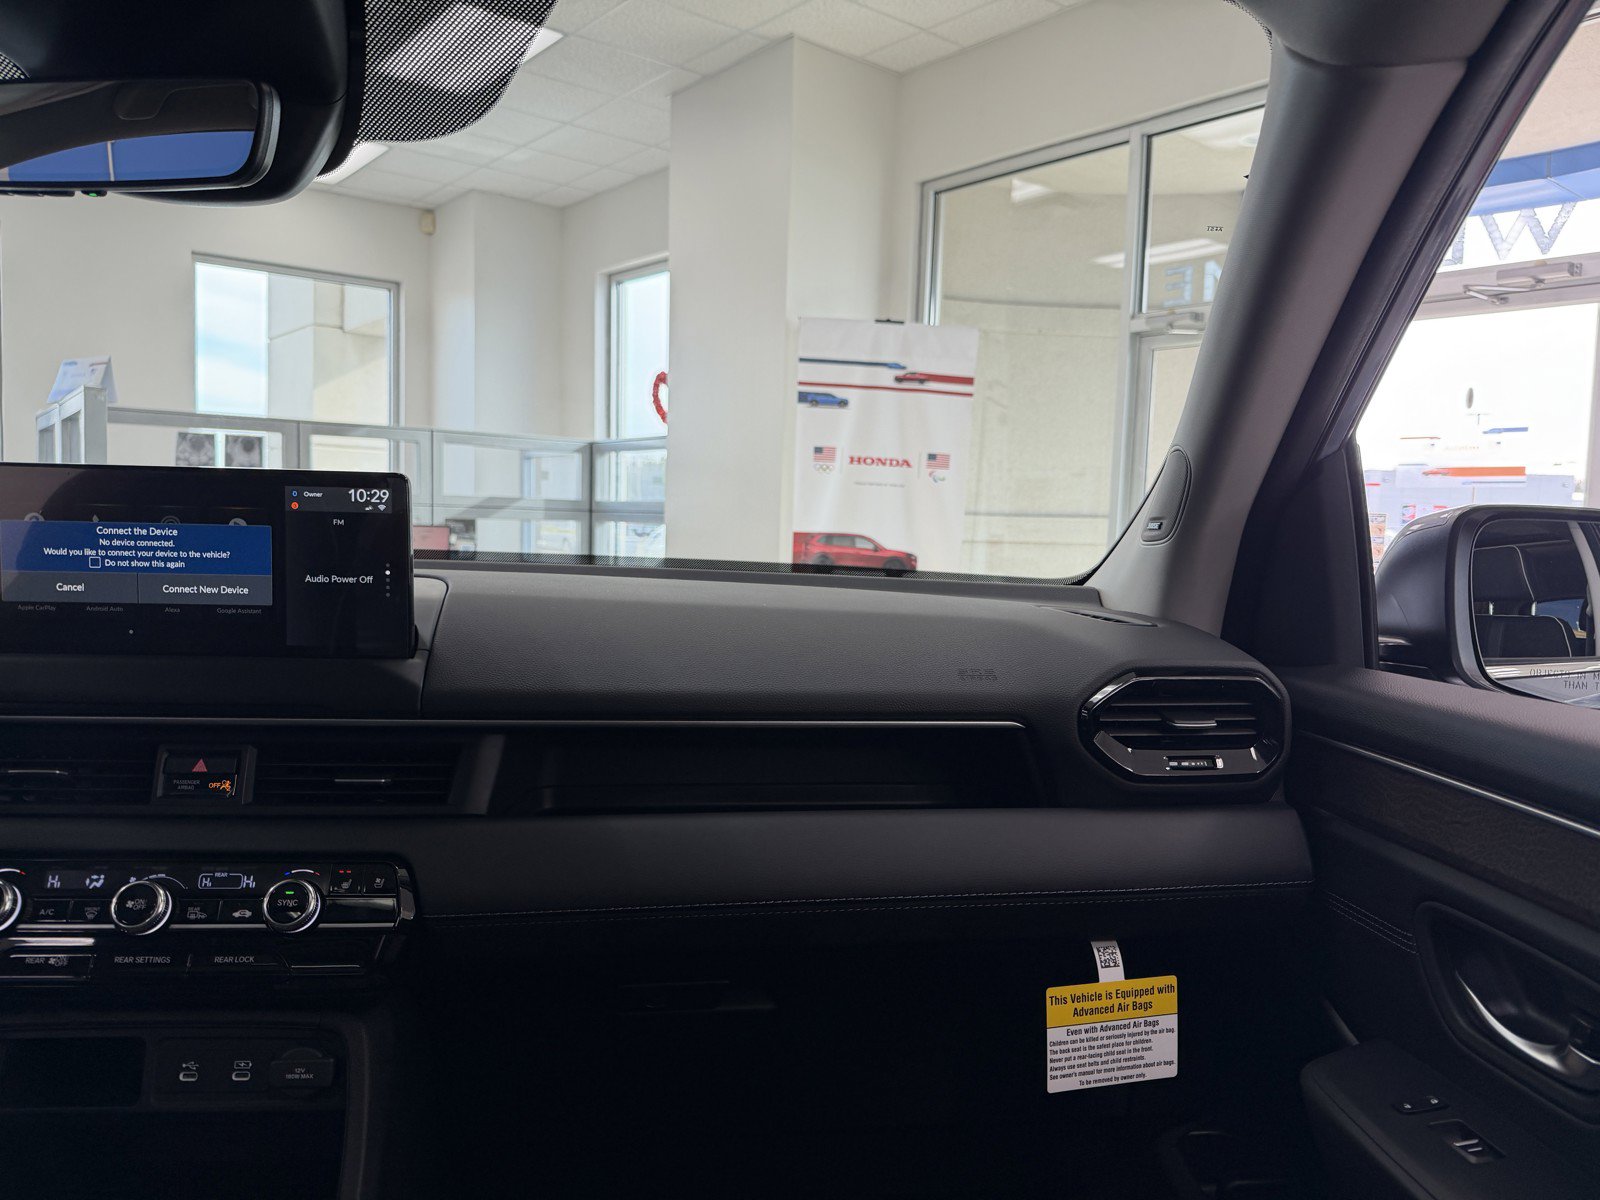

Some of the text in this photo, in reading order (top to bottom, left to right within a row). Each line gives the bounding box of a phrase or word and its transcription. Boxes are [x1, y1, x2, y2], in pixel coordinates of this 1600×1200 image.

[849, 456, 913, 468] HONDA
[348, 489, 389, 503] 10:29
[96, 526, 132, 535] Connect
[149, 528, 178, 536] Device
[99, 538, 110, 546] No
[111, 538, 135, 546] device
[69, 549, 82, 557] you
[84, 548, 97, 556] like
[107, 549, 136, 557] connect
[155, 550, 178, 558] device
[188, 550, 201, 558] the
[105, 559, 116, 567] Do
[151, 560, 165, 568] this
[166, 560, 186, 569] again
[304, 574, 374, 584] Audio Power Off
[56, 582, 85, 592] Cancel
[162, 584, 249, 595] Connect New Device
[1564, 680, 1588, 690] THAN
[277, 899, 299, 907] SYNC
[39, 908, 55, 916] A/C
[114, 956, 171, 964] REAR SETTINGS
[1049, 983, 1175, 1006] This Vehicle is Equipped with
[1073, 1001, 1153, 1017] Advanced Air Bags
[1066, 1019, 1160, 1036] Even with Advanced Air Bags
[1127, 1030, 1143, 1038] injured
[1116, 1063, 1142, 1072] information
